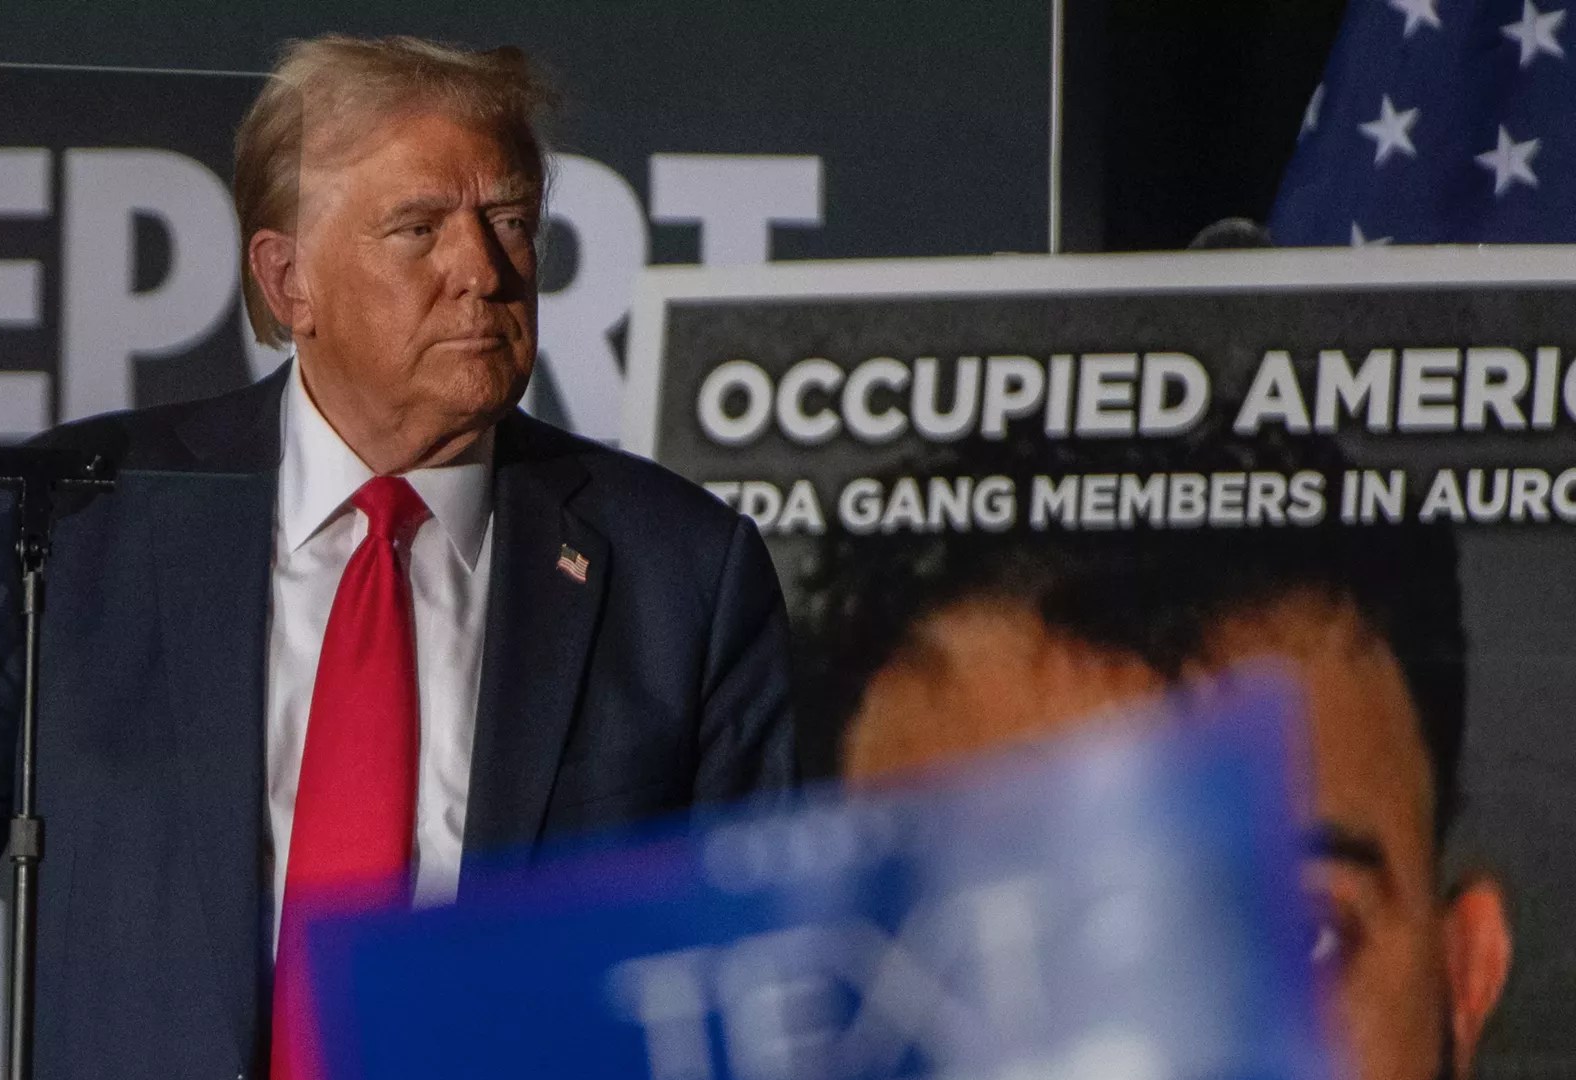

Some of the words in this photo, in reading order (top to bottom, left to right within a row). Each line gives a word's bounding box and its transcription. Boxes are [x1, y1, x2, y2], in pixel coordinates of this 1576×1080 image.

[698, 352, 1212, 446] OCCUPIED
[1233, 347, 1576, 436] AMERI
[838, 475, 1017, 534] GANG
[1029, 471, 1327, 531] MEMBERS
[1340, 469, 1406, 525] IN
